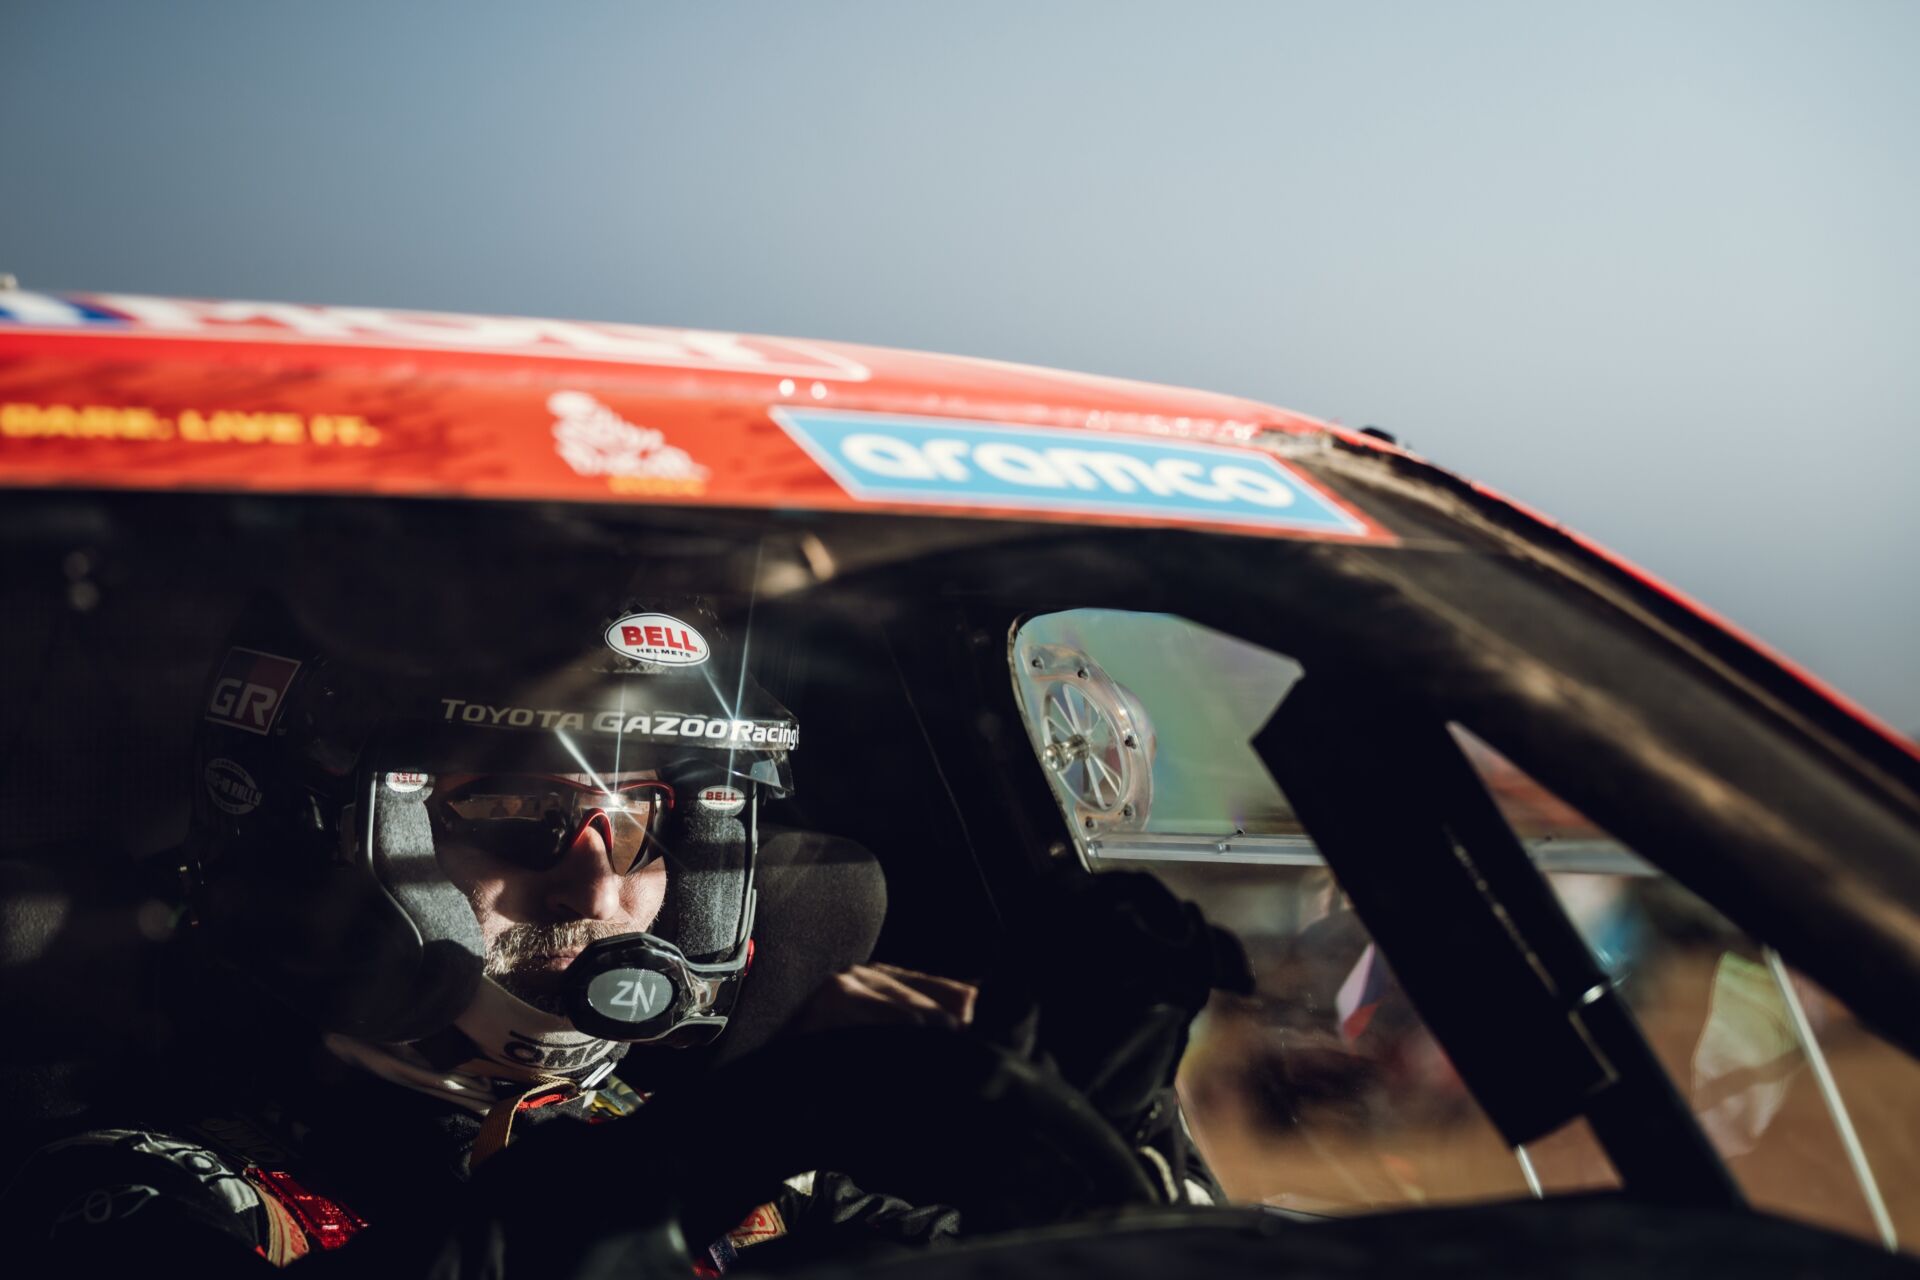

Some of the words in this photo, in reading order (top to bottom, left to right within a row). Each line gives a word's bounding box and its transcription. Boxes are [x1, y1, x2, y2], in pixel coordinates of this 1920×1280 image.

[838, 432, 1296, 508] aramco
[621, 626, 698, 652] BELL
[637, 648, 691, 658] HELMETS
[210, 677, 278, 727] GR
[442, 698, 585, 730] TOYOTA
[592, 711, 728, 739] GAZOO
[705, 791, 737, 802] BELL
[610, 980, 657, 1014] ZN
